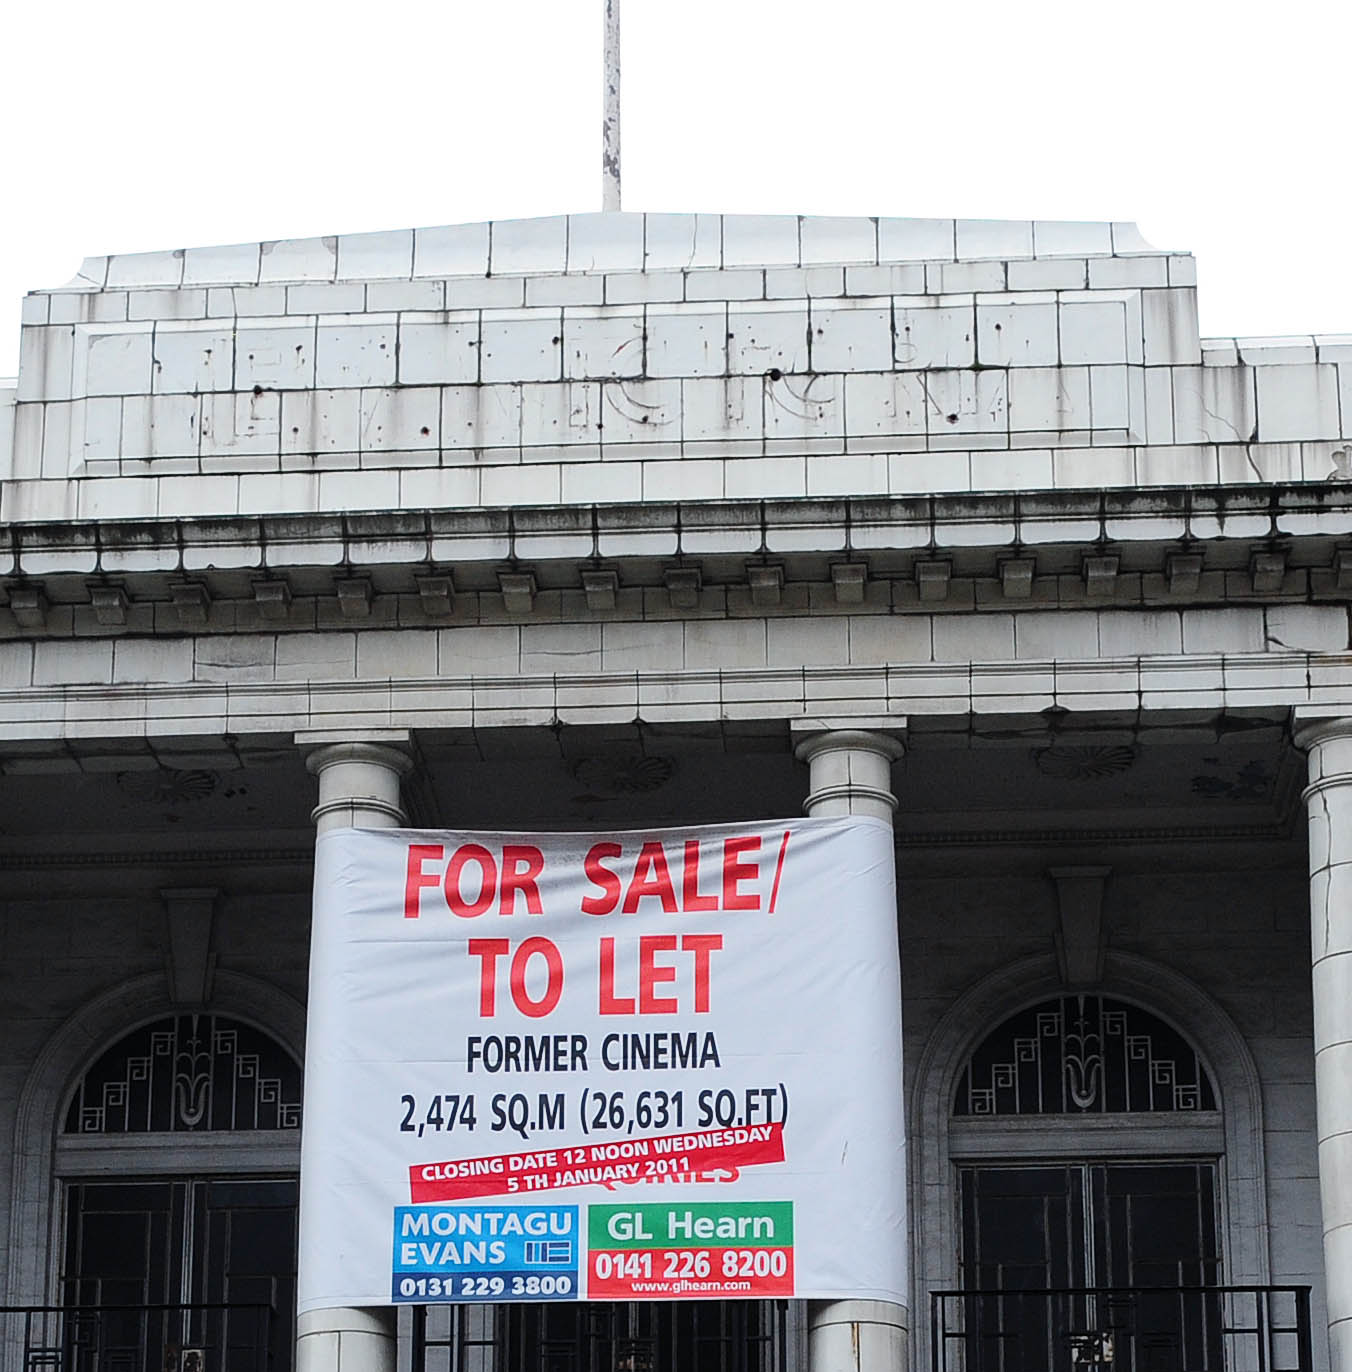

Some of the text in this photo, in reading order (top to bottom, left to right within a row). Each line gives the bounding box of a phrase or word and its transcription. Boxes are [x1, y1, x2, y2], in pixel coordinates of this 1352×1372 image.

[403, 831, 790, 918] FOR SALE/
[468, 934, 723, 1018] TO LET
[466, 1031, 721, 1073] FORMER CINEMA
[399, 1083, 789, 1139] 2,474 SQ.M (26,631 SQ.FT)
[421, 1125, 773, 1182] CLOSING DATE 12 NOON WEDNESDAY
[507, 1176, 518, 1192] 5
[525, 1174, 549, 1190] TH
[553, 1162, 640, 1187] JANUARY
[646, 1156, 690, 1175] 2011
[400, 1212, 572, 1238] MONTAGU
[607, 1211, 775, 1241] GL Hearn
[400, 1241, 506, 1265] EVANS
[595, 1250, 788, 1279] 0141 226 8200
[400, 1275, 572, 1297] 0131 229 3800
[631, 1279, 752, 1294] www.glhearn.com
